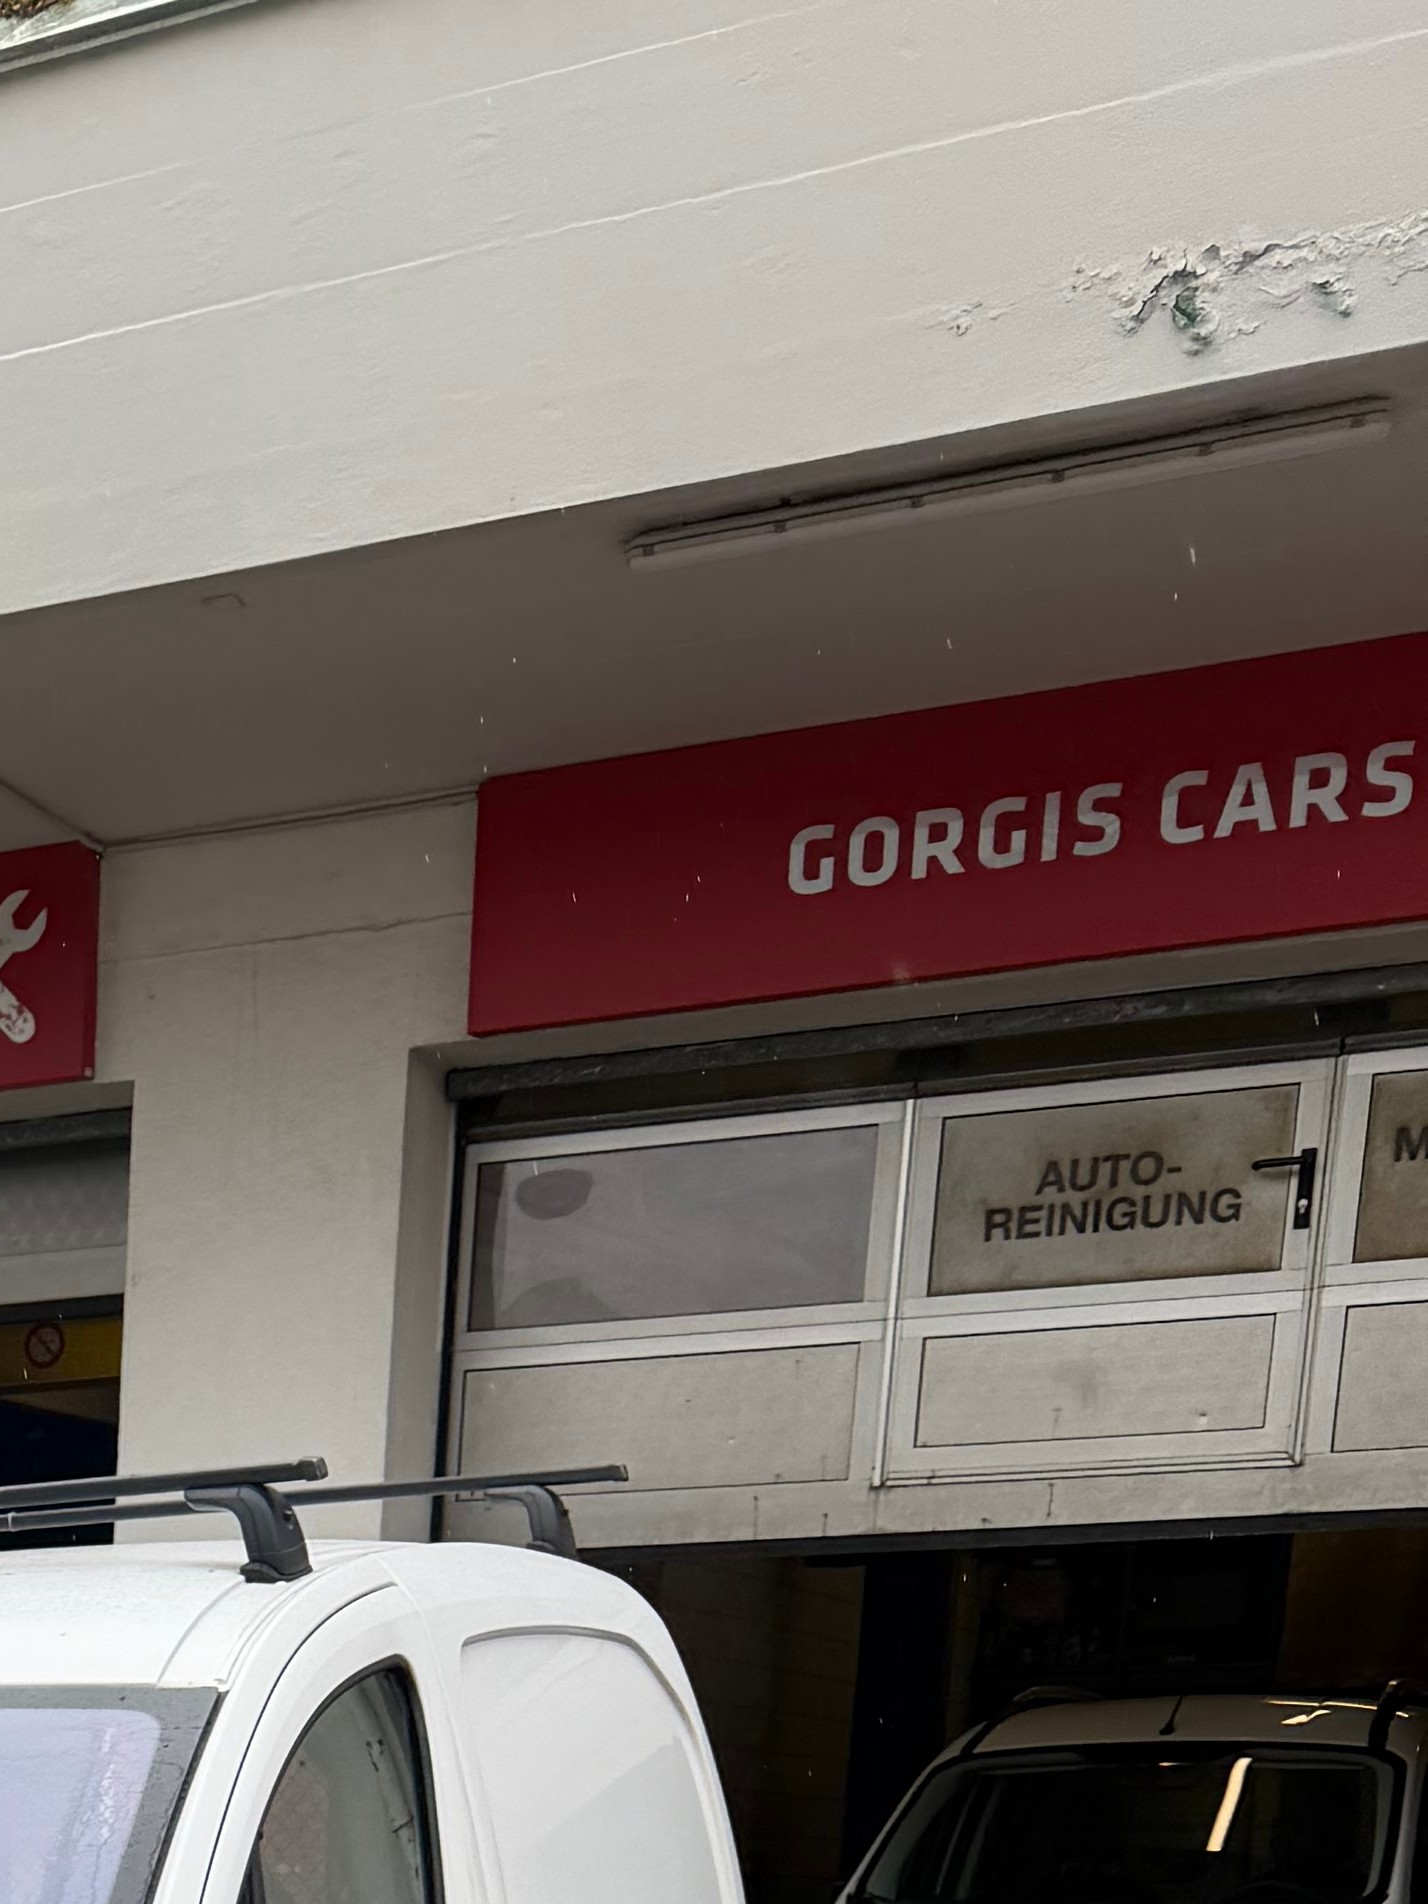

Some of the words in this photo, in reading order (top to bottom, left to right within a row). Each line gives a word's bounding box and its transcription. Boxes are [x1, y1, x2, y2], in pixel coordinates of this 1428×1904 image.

[788, 781, 1124, 895] GORGIS
[1159, 739, 1416, 845] CARS
[1036, 1150, 1182, 1196] AUTO-
[983, 1188, 1242, 1242] REINIGUNG
